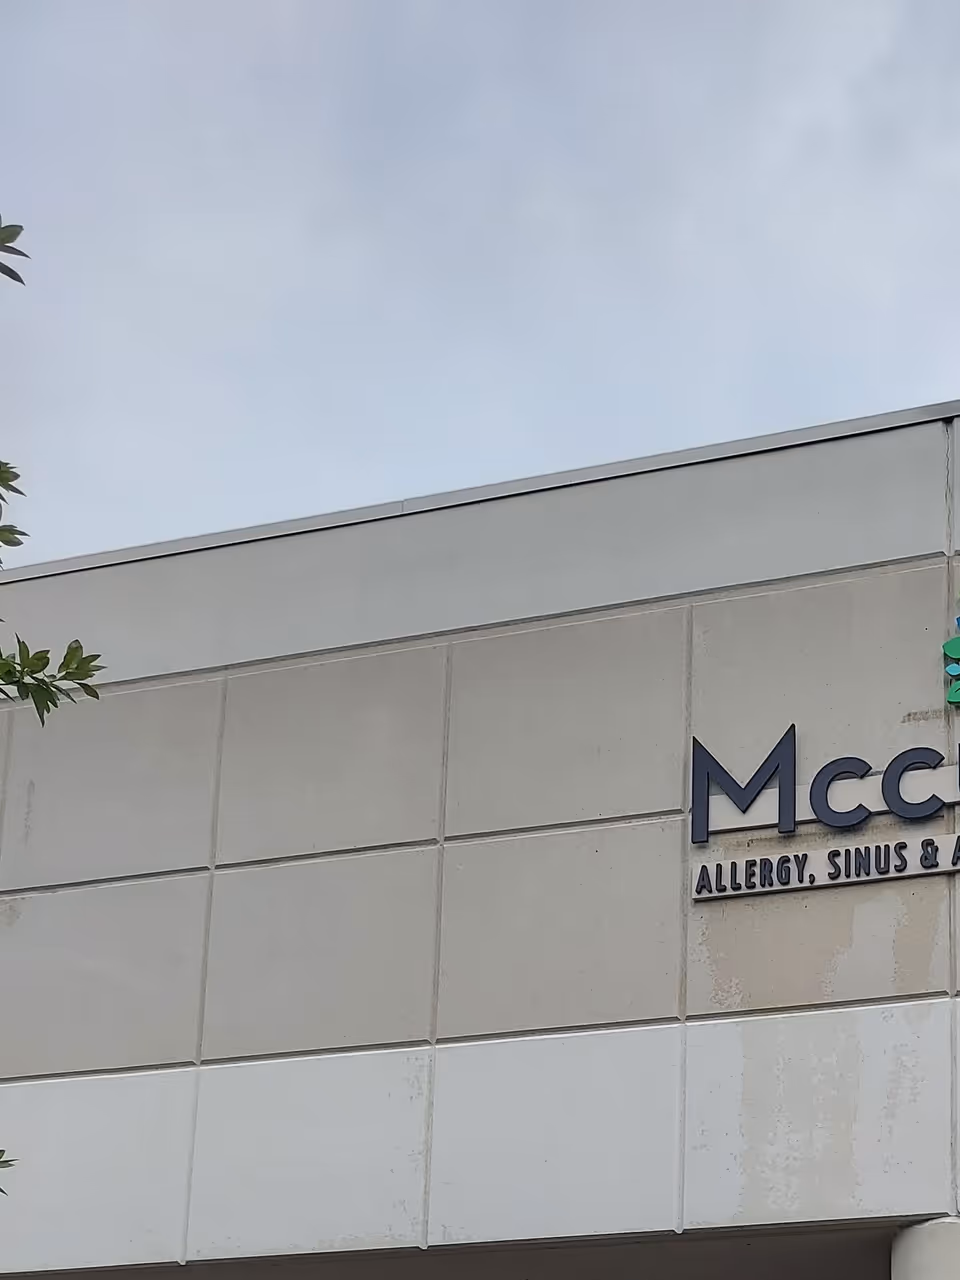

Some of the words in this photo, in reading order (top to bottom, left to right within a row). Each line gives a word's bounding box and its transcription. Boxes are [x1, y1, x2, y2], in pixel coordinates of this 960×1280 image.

[695, 853, 815, 895] ALLERGY,
[827, 841, 908, 880] SINUS
[920, 838, 940, 869] &
